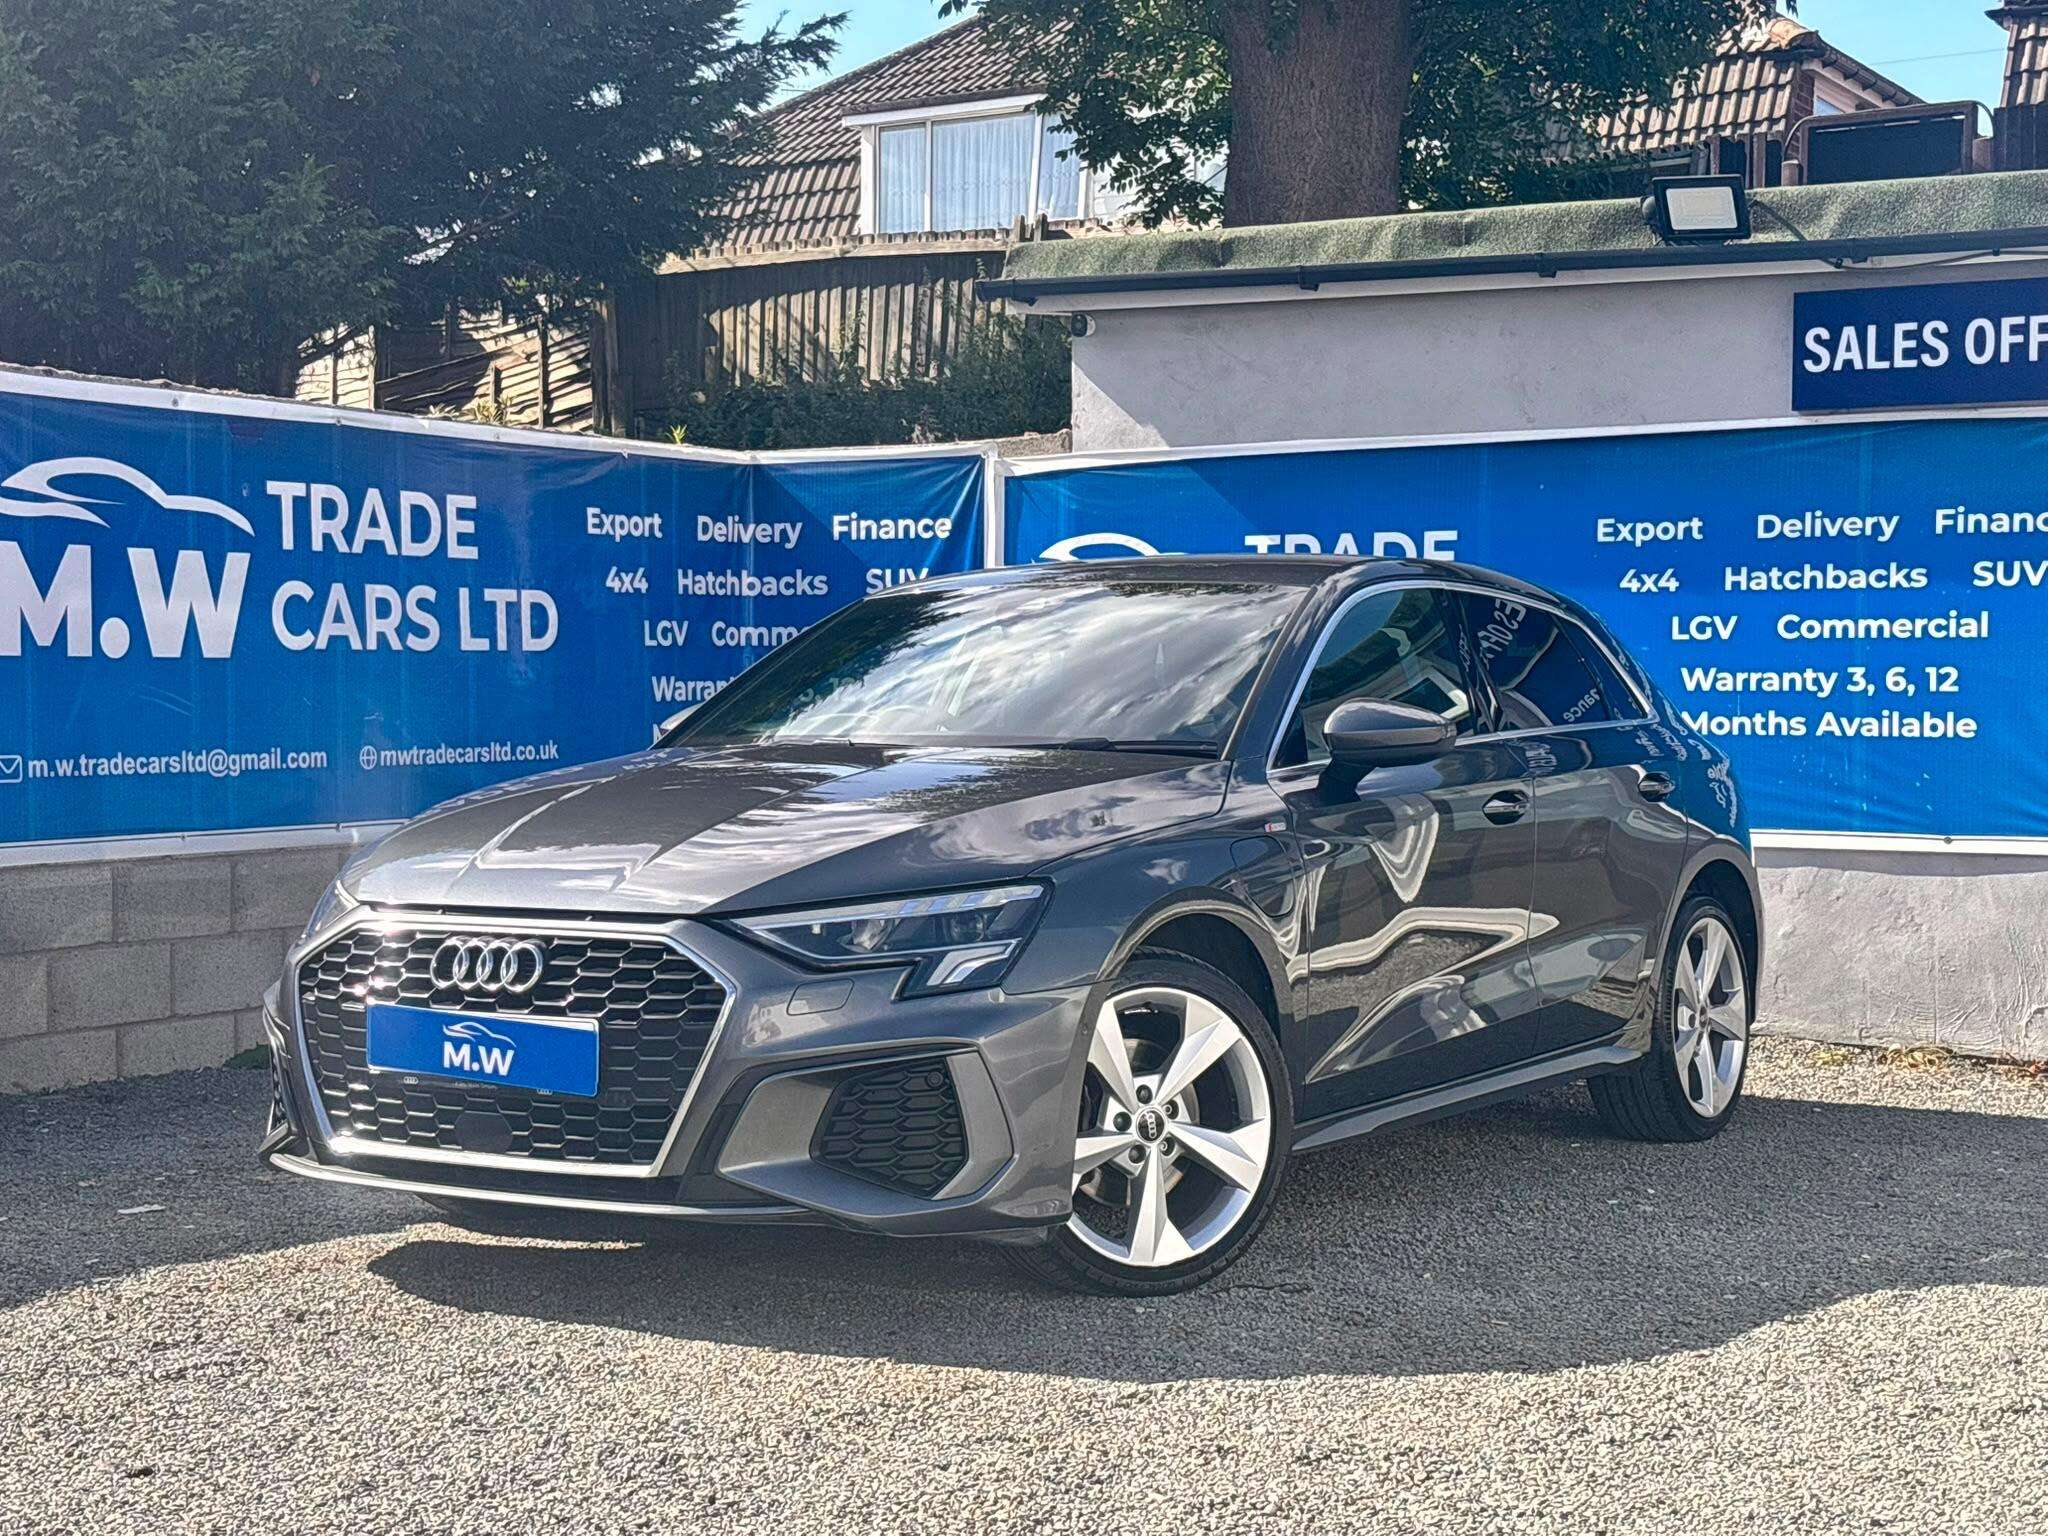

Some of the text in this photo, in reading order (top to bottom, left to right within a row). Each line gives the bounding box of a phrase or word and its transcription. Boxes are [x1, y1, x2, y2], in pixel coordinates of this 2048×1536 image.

[1803, 319, 1950, 373] SALES
[266, 480, 479, 560] TRADE
[586, 507, 952, 549] Export Delivery Finance
[1596, 517, 1704, 547] Export
[1757, 511, 1899, 542] Delivery
[605, 566, 649, 594] 4x4
[677, 569, 829, 597] Hatchbacks
[1619, 568, 1679, 592] 4x4
[1725, 563, 1928, 591] Hatchbacks
[0, 540, 252, 659] M.W
[271, 580, 559, 652] CARS LTD
[644, 620, 689, 647] LGV
[1671, 610, 1989, 640] LGV Commercial
[1680, 667, 1959, 698] Warranty 3, 6, 12
[1681, 711, 1807, 736] Months
[1816, 711, 1978, 738] Available
[28, 740, 559, 779] m.w.tradecarsltd@gmail.com mwtradecarsltd.co.uk
[443, 1041, 515, 1076] M.W
